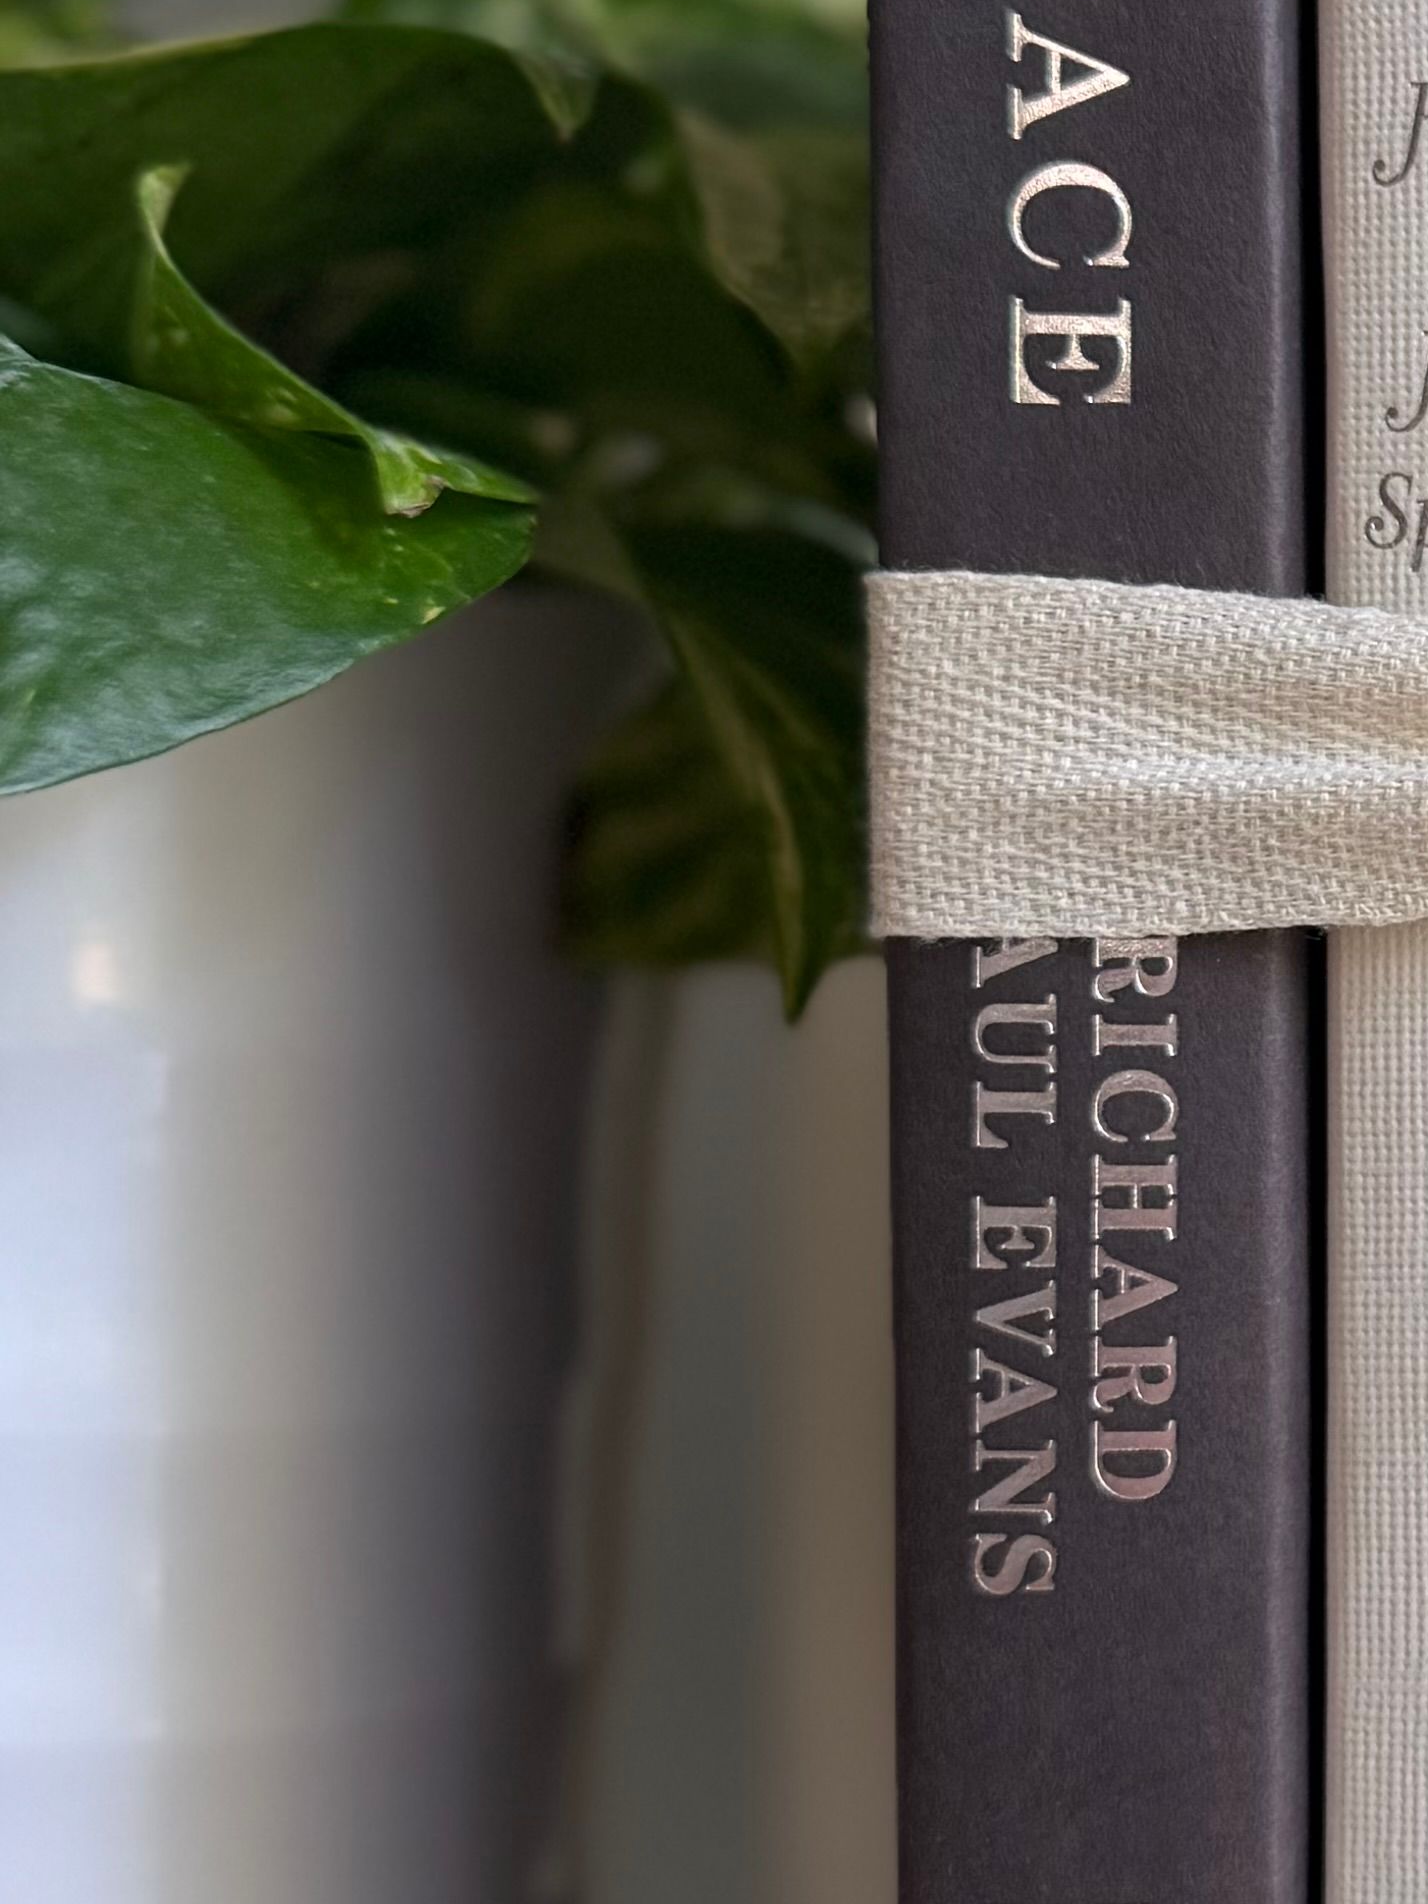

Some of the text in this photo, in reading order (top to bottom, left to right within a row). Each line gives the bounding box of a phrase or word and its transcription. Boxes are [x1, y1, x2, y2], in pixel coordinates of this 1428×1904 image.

[971, 937, 1059, 1597] AUL EVANS
[1089, 937, 1180, 1500] RICHARD
